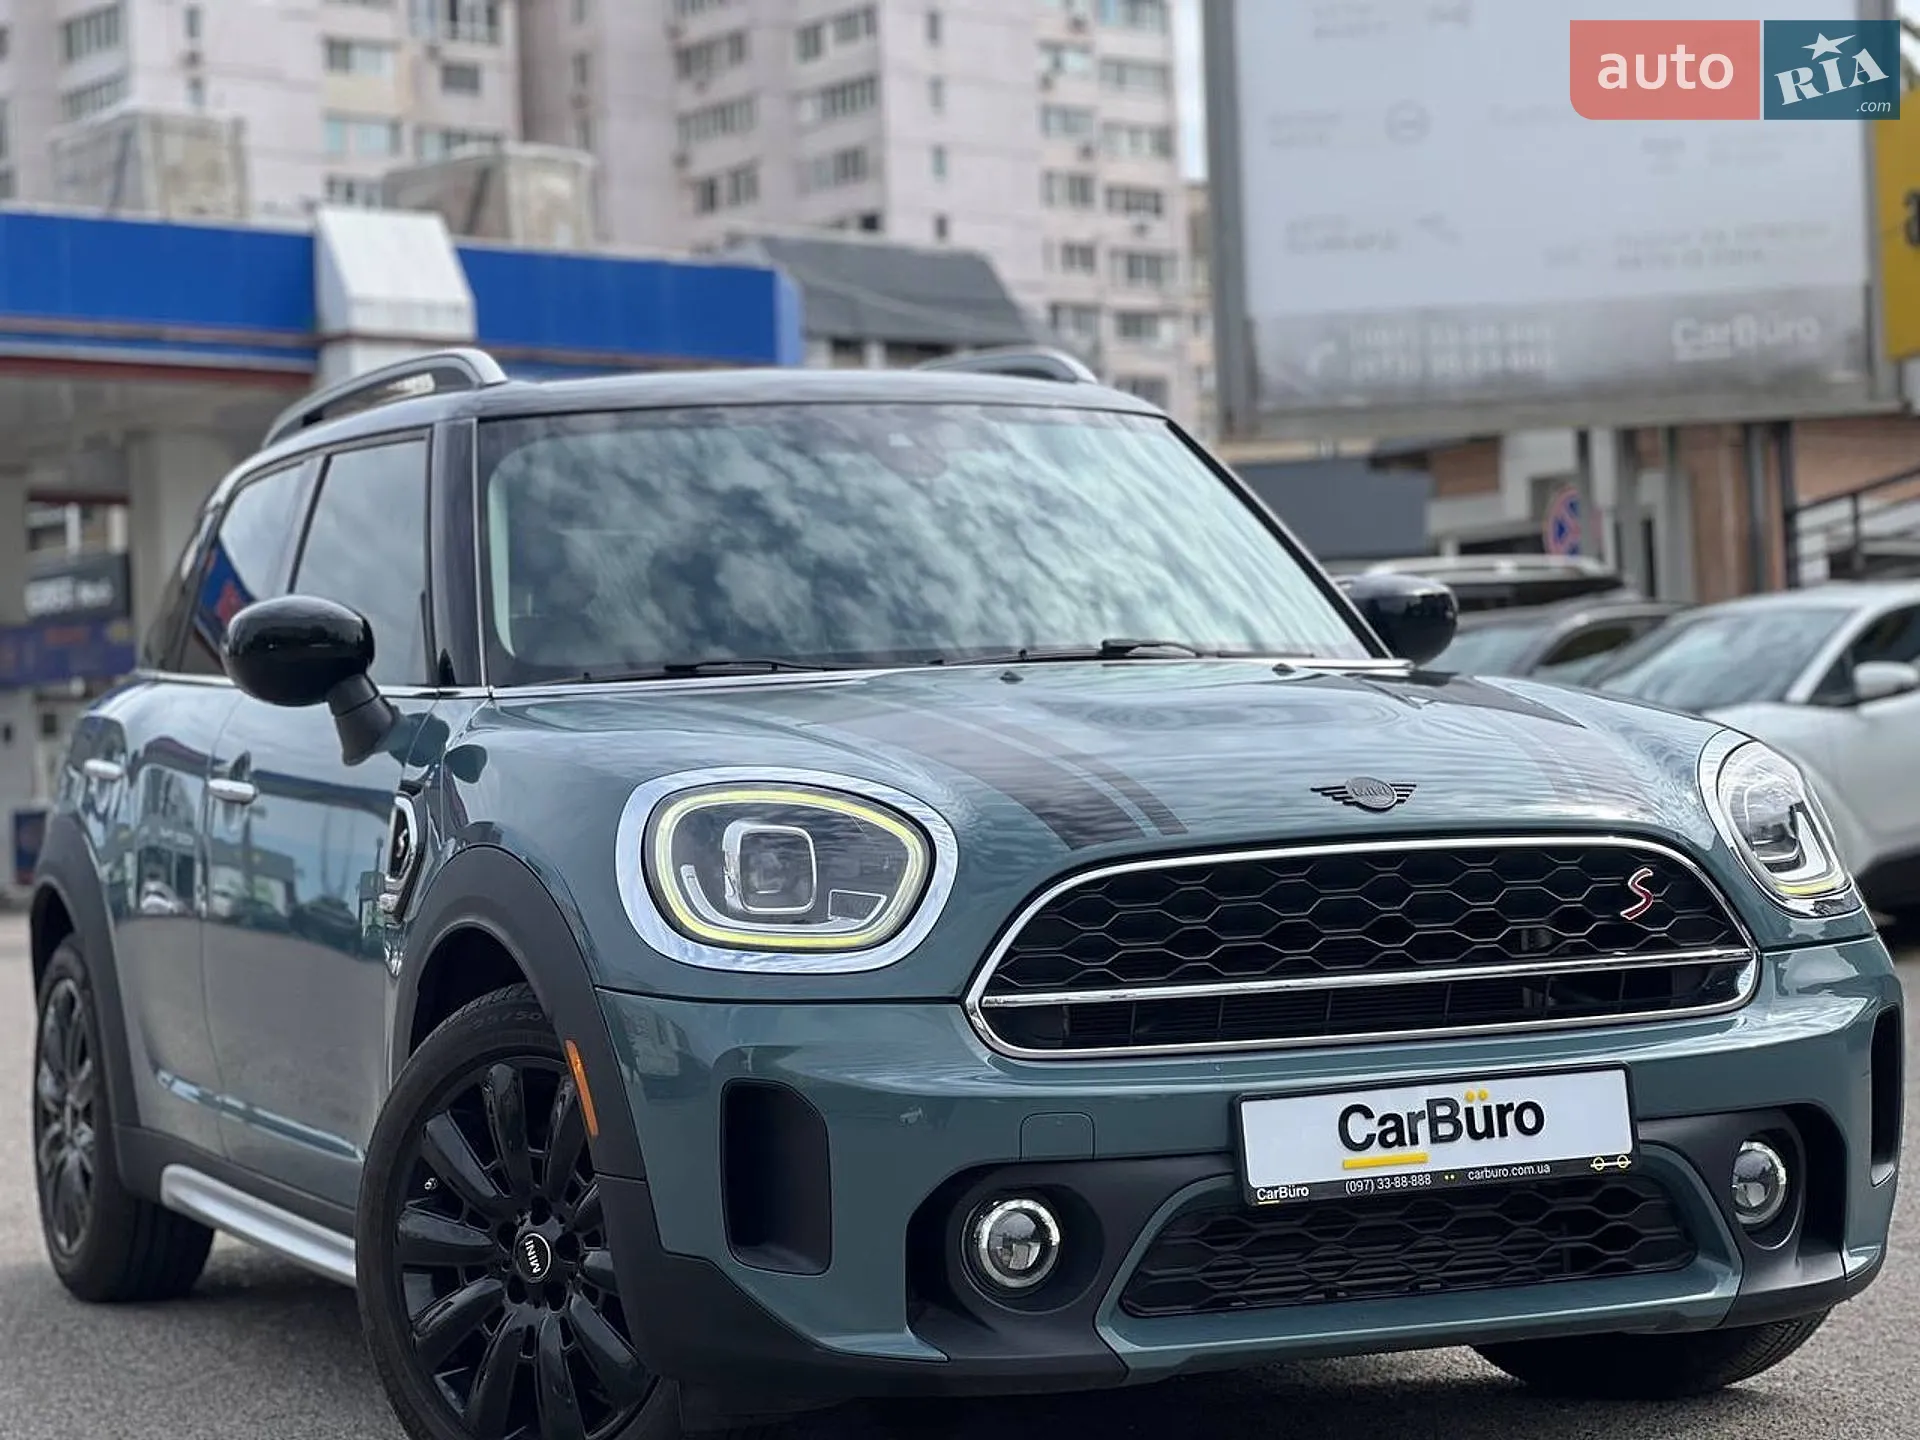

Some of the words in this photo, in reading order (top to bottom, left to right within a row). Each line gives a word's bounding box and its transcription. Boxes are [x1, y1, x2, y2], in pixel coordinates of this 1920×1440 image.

[1620, 867, 1654, 920] S
[1338, 1088, 1545, 1152] CarBüro
[1256, 1185, 1309, 1201] CarBüro
[1345, 1179, 1375, 1195] (097)
[1377, 1173, 1432, 1190] 33-88-888
[525, 1240, 541, 1273] MINI
